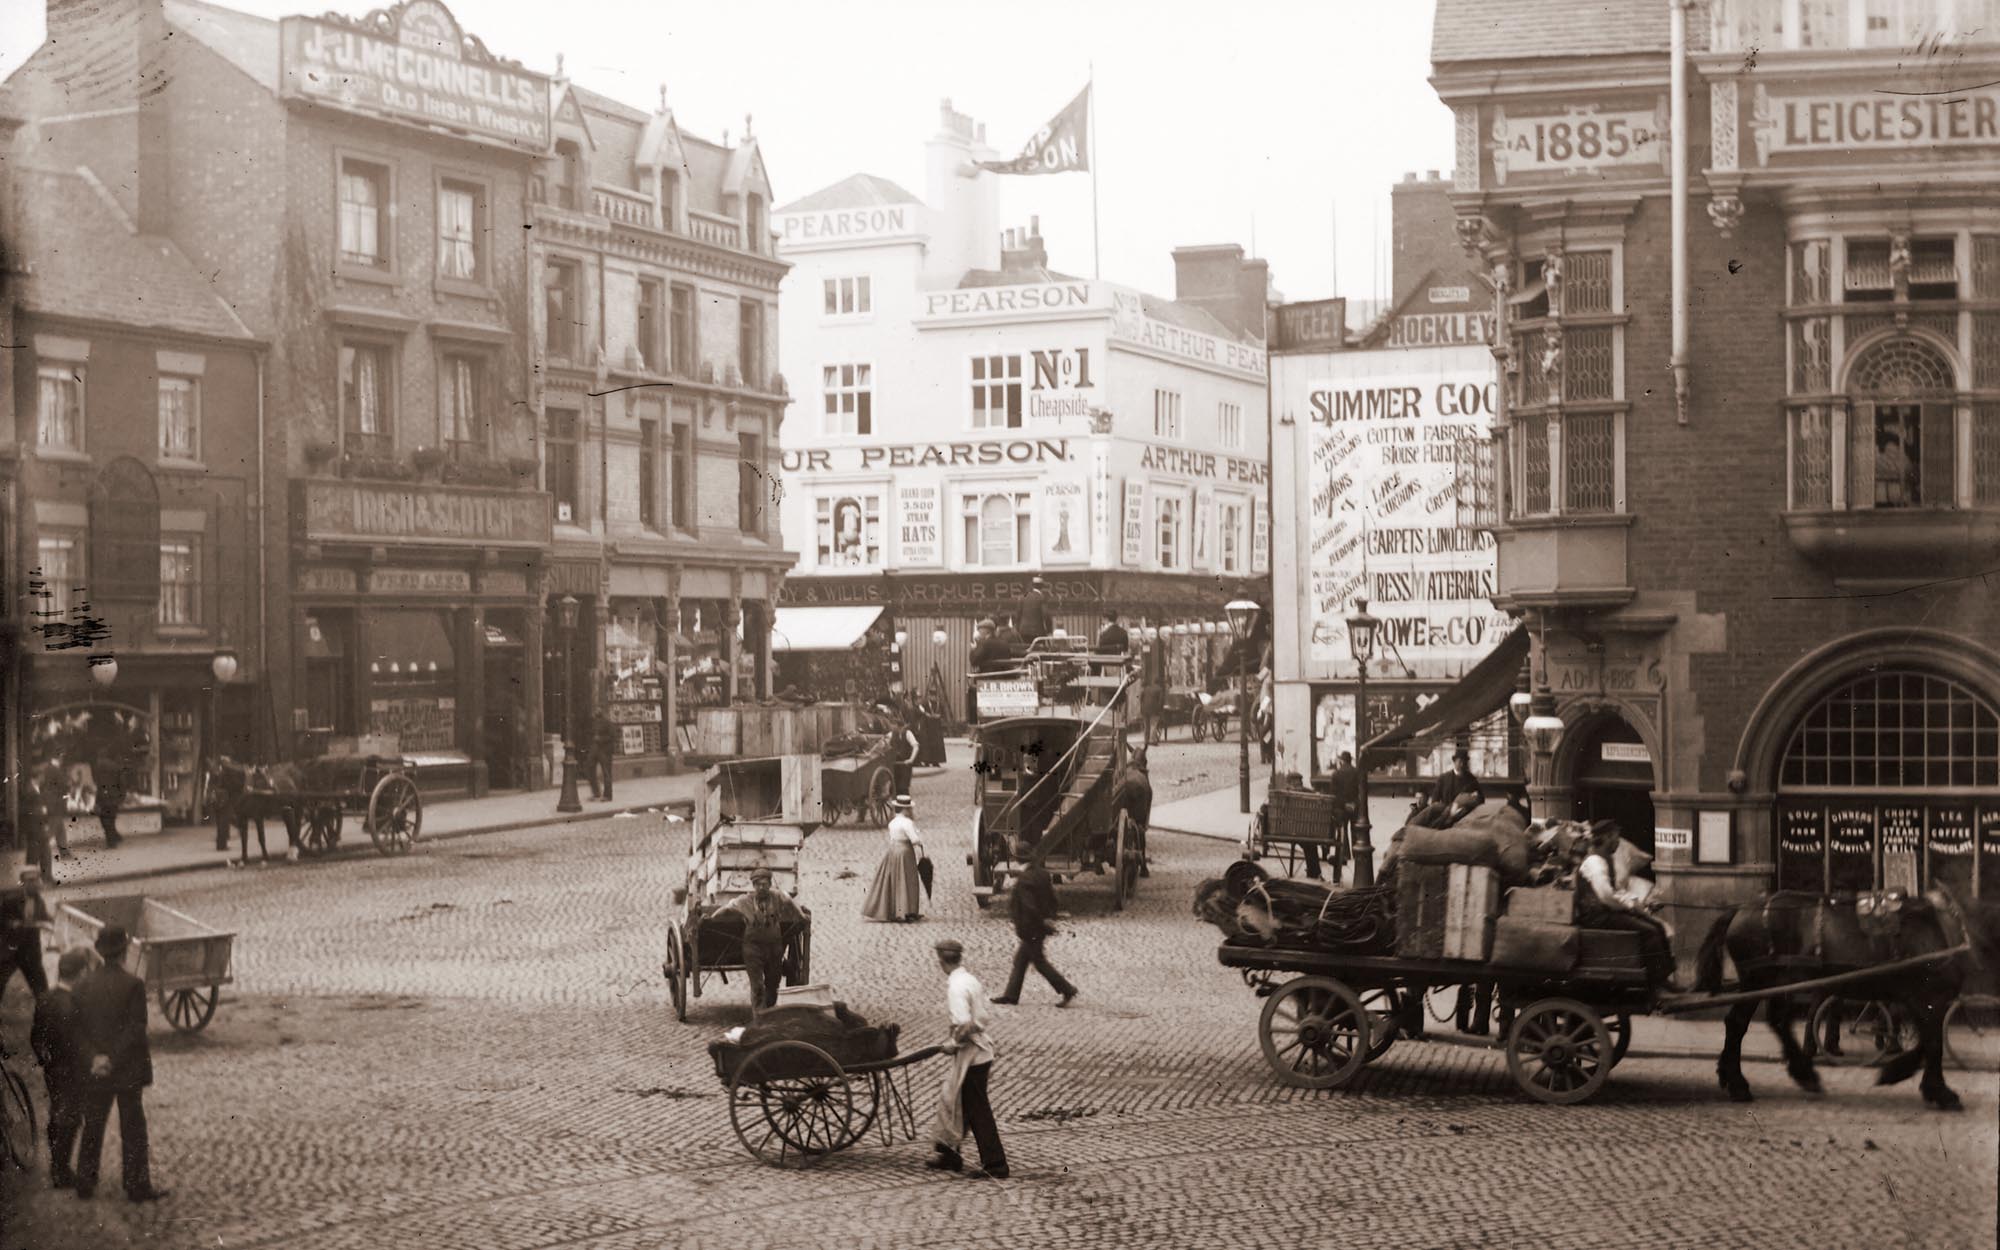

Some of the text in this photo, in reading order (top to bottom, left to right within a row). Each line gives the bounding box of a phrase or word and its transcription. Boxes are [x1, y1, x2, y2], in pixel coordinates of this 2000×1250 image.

[383, 84, 542, 137] OLD IRISH WHISKY
[1785, 97, 1997, 144] LEICESTER
[1536, 120, 1628, 162] 1885
[784, 207, 905, 237] PEARSON
[926, 284, 1090, 316] PEARSON
[1142, 321, 1216, 361] ARTHUR
[1309, 386, 1422, 422] SUMMER
[1366, 424, 1477, 445] COTTON FABRICS
[1140, 445, 1216, 478] ARTHUR
[1371, 471, 1401, 504] LACE
[353, 489, 415, 533] IRISH
[902, 525, 936, 543] HATS
[1367, 528, 1424, 556] CARPETS
[807, 587, 818, 602] &
[824, 584, 880, 601] WILLIS
[902, 580, 1098, 600] ARTHUR PERSON
[1368, 570, 1493, 601] DRESS MATERIALS
[1788, 810, 1818, 822] SOUP
[1832, 810, 1872, 824] DINNERS
[1884, 808, 1919, 818] CHOPS
[1892, 818, 1911, 827] AND
[1940, 811, 1963, 823] TEA
[1791, 827, 1816, 836] FROM
[1840, 827, 1864, 836] FROM
[1883, 826, 1920, 836] STEAKS
[1931, 827, 1971, 838] COFFEE
[1884, 845, 1915, 854] GRILL
[1929, 839, 1973, 855] CHOCOLATE
